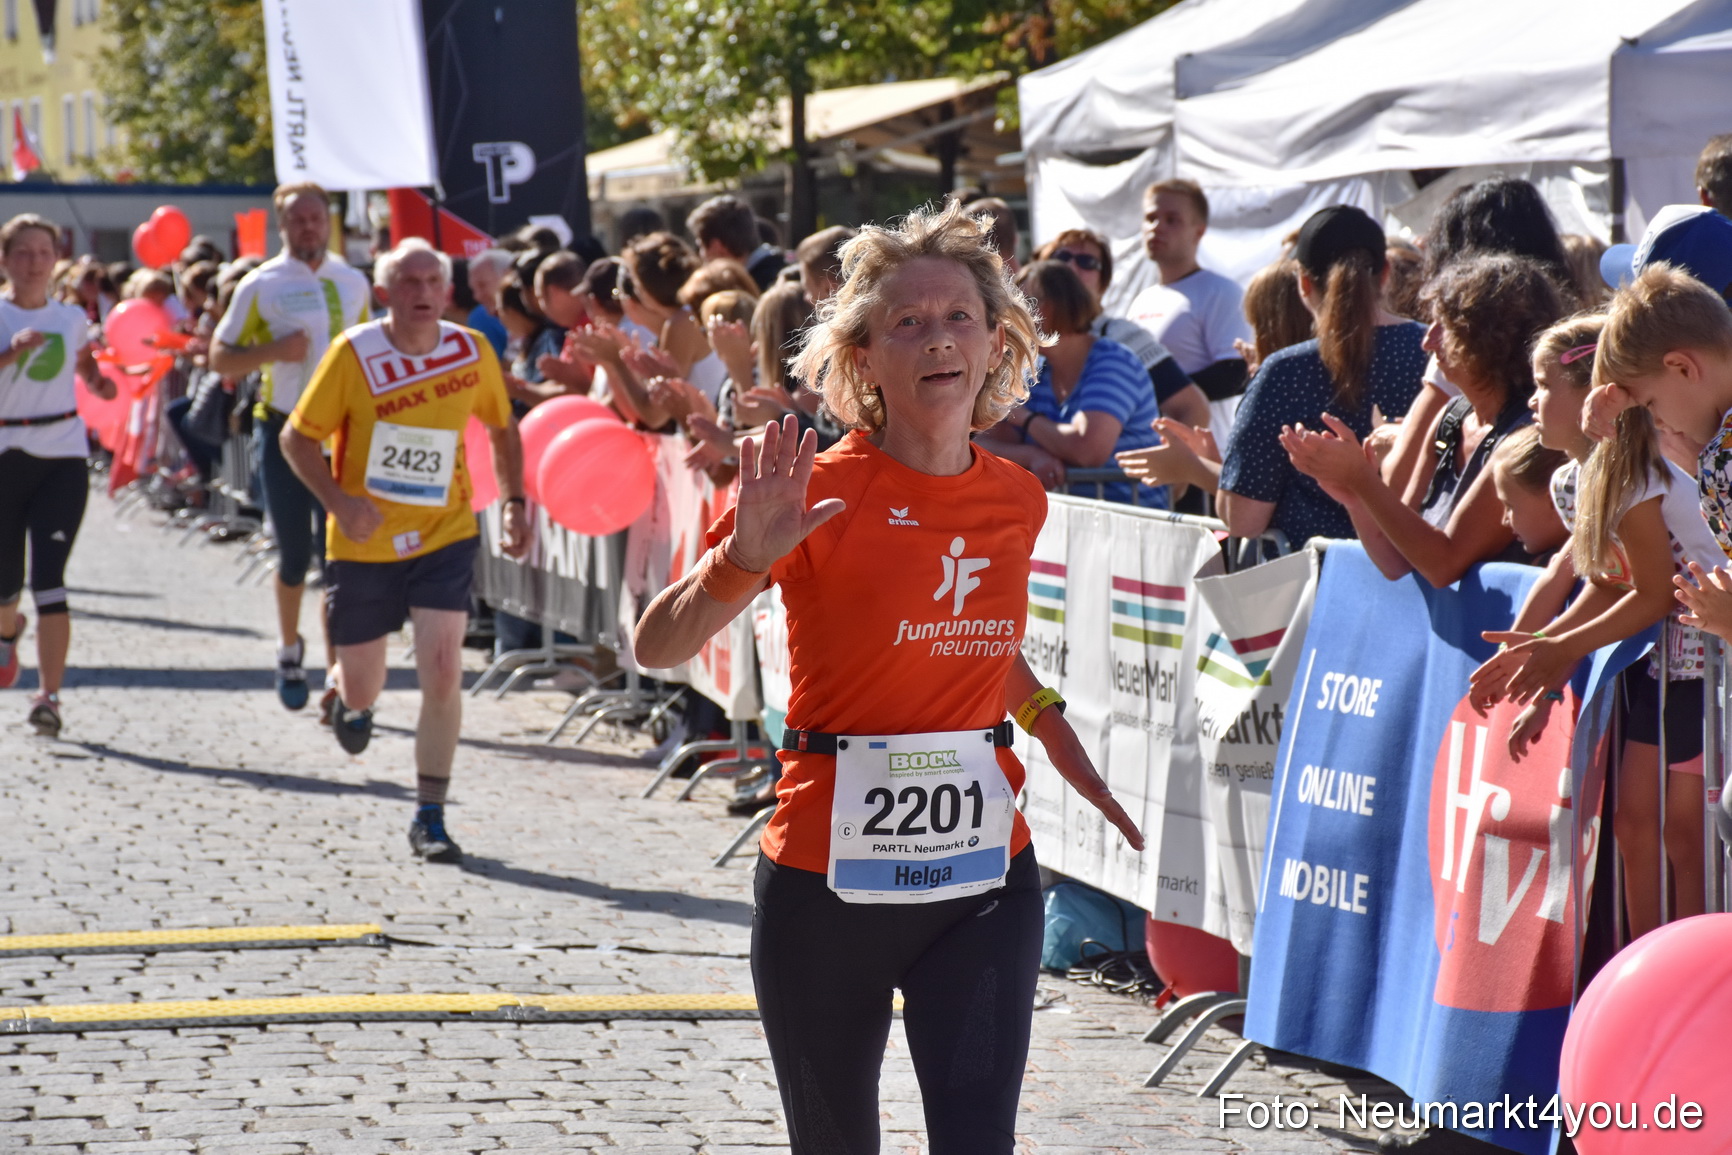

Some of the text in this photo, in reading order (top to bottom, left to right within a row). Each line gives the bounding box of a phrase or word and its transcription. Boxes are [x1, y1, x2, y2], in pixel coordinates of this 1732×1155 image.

[375, 389, 429, 420] MAX
[381, 445, 442, 474] 2423
[888, 518, 920, 526] erima
[893, 619, 1015, 646] funrunners
[1316, 671, 1382, 717] STORE
[889, 750, 961, 771] BOCK
[889, 771, 914, 779] inspired
[1298, 764, 1376, 817] ONLINE
[862, 780, 984, 836] 2201
[872, 840, 964, 853] PARTL Neumarkt
[894, 864, 952, 888] Helga
[1279, 858, 1370, 914] MOBILE
